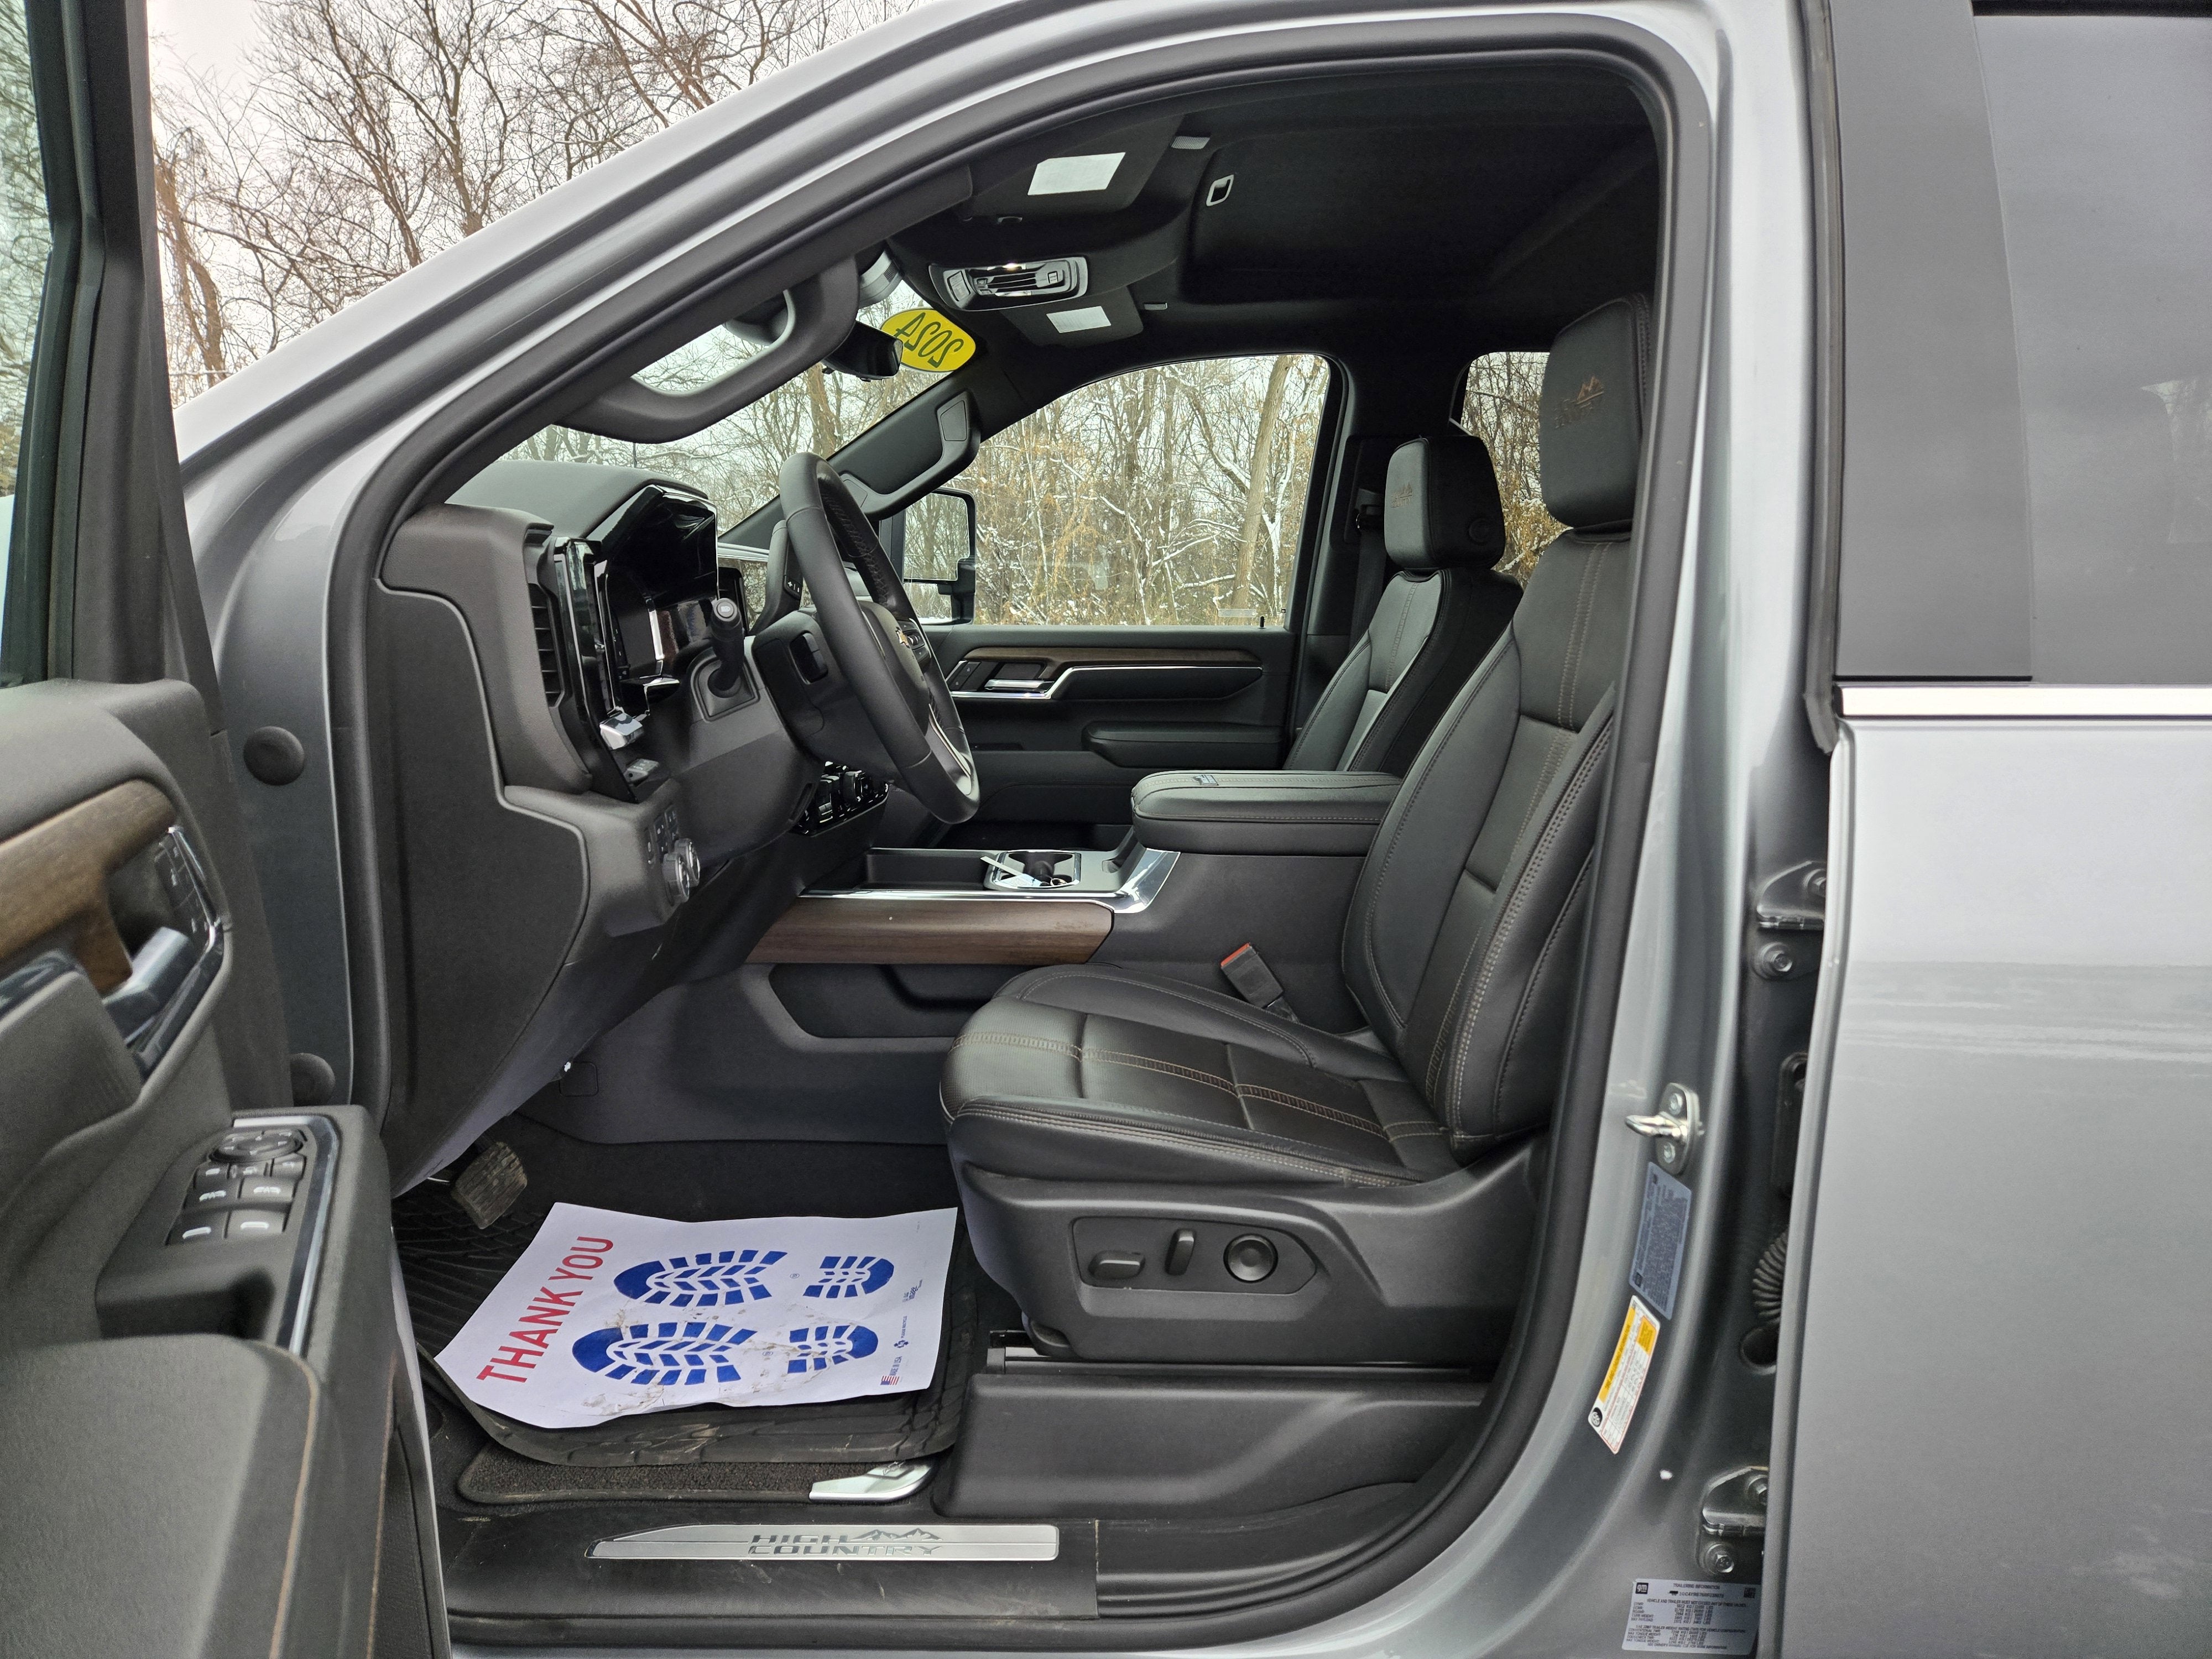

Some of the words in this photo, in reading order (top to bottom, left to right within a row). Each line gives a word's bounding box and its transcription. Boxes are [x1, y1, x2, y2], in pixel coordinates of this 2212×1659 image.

[476, 1286, 583, 1383] THANK
[547, 1236, 614, 1280] YOU
[751, 1535, 848, 1545] HIGH
[748, 1545, 942, 1556] COUNTRY
[1637, 1584, 1647, 1593] gm
